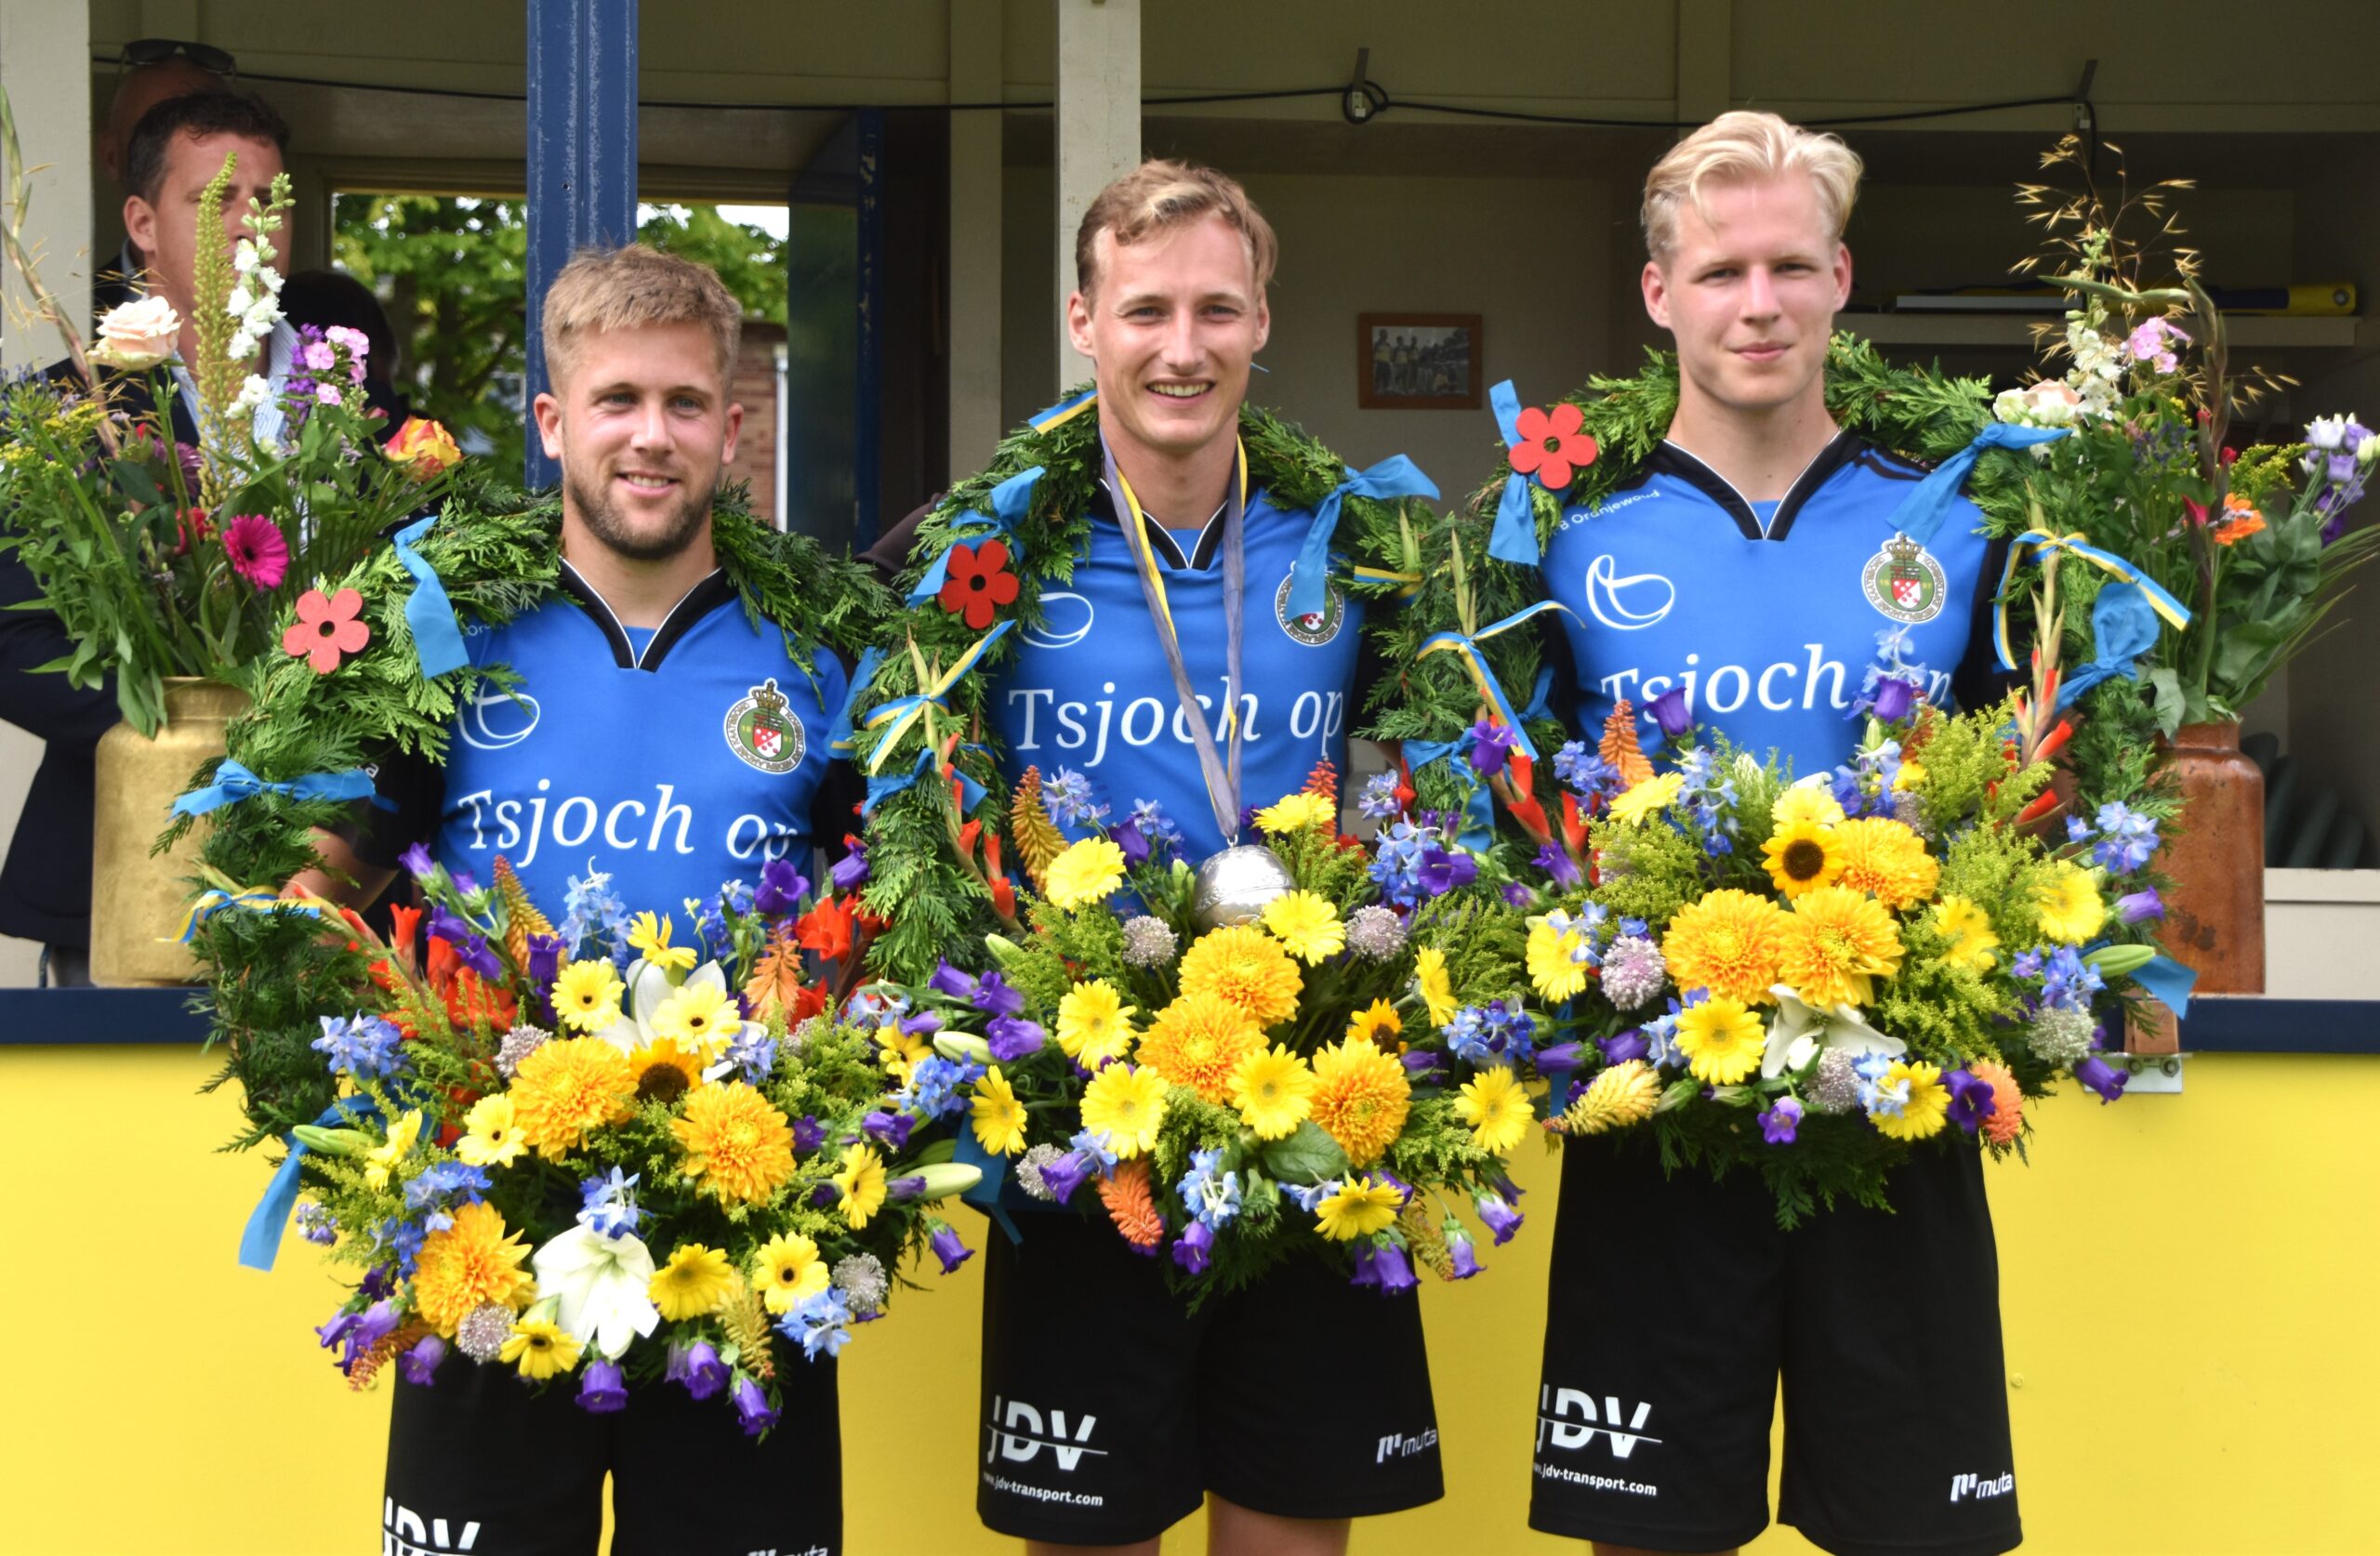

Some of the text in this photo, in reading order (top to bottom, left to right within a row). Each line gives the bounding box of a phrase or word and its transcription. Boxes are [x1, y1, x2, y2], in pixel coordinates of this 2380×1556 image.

[1009, 676, 1342, 768] Tsjoch op
[458, 779, 799, 879] Tsjoch op
[986, 1394, 1097, 1471] JDV
[1535, 1384, 1652, 1458] JDV
[1976, 1470, 2013, 1499] muta
